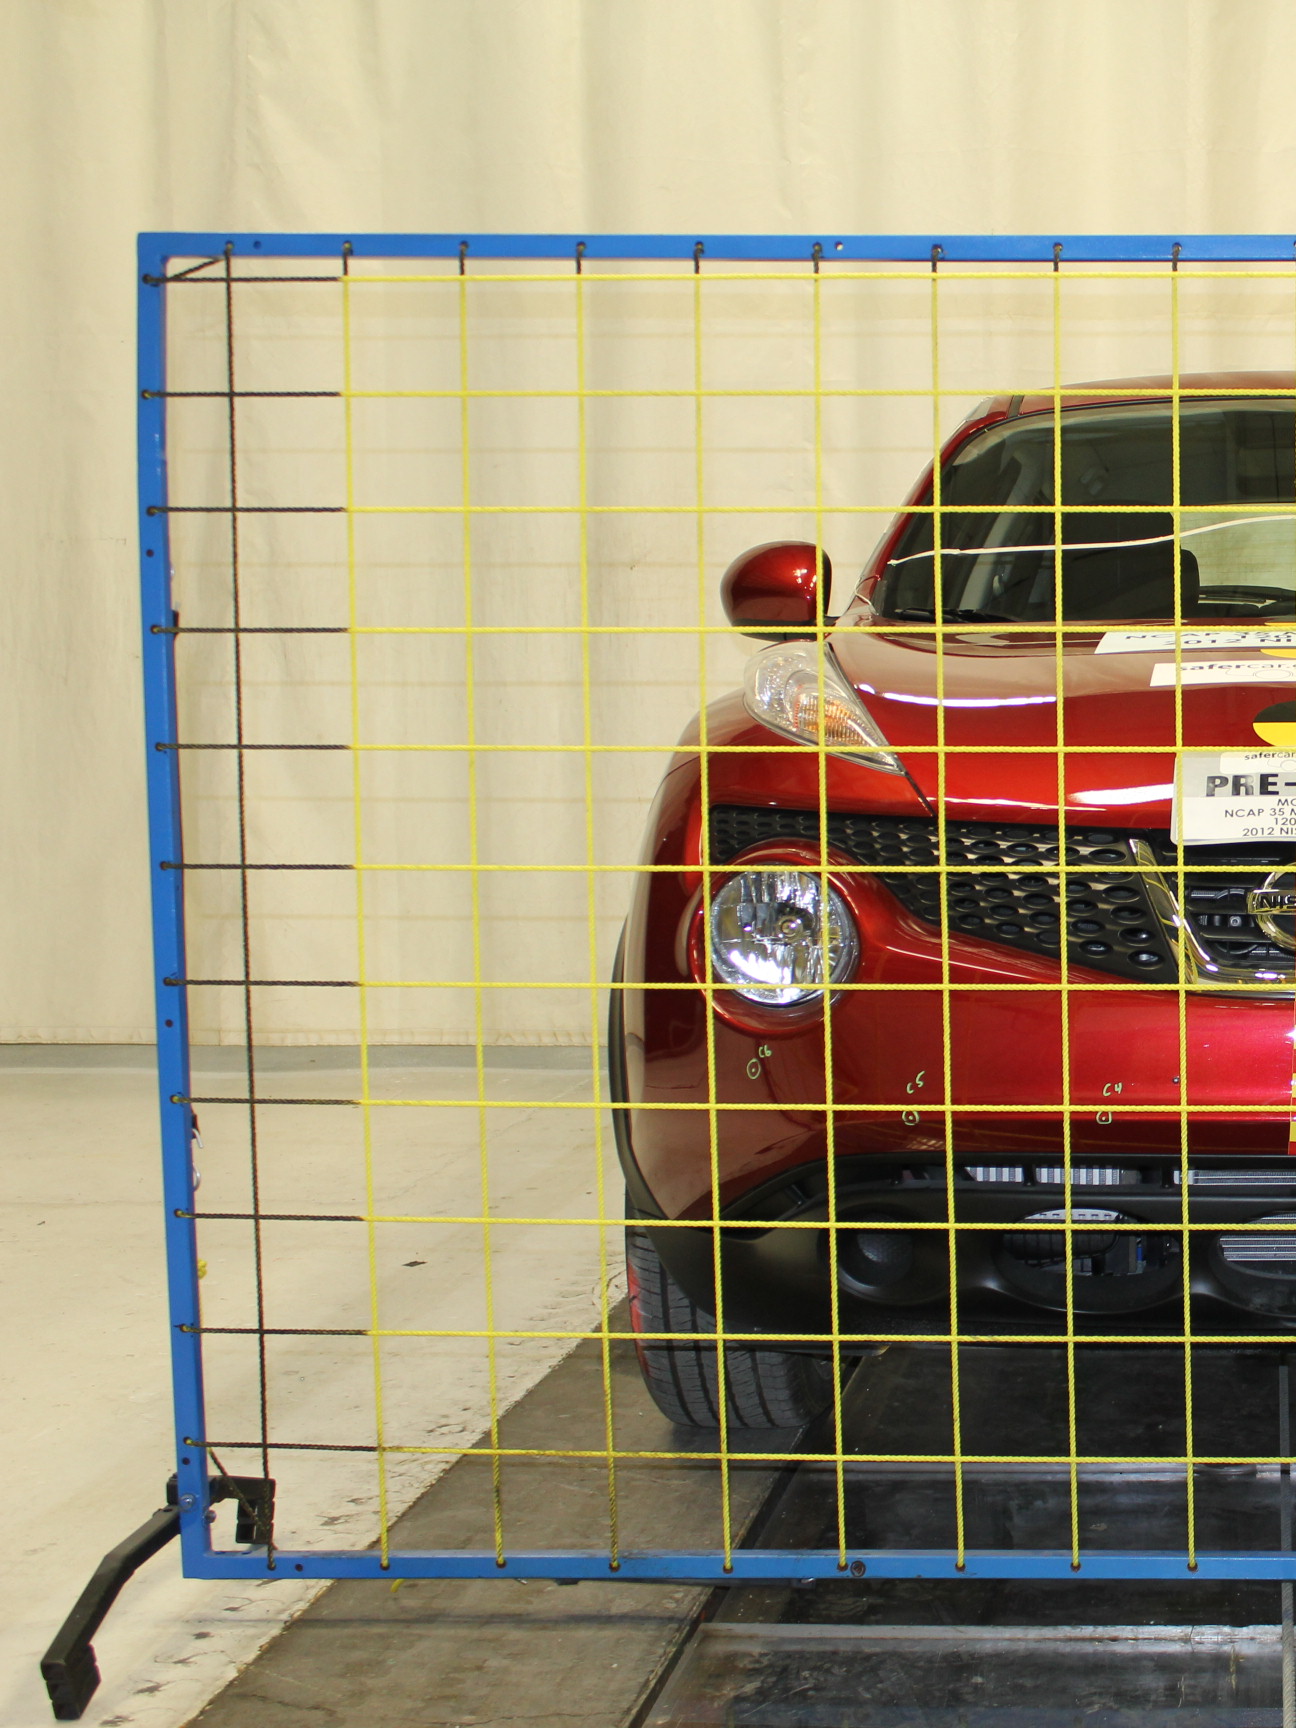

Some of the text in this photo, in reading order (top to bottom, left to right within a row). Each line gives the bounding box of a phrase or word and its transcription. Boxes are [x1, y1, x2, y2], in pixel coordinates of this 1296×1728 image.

[1125, 632, 1220, 640] NCAP
[1164, 638, 1242, 646] 2012
[1224, 808, 1265, 818] NCAP
[1269, 807, 1285, 817] 35
[1242, 827, 1275, 837] 2012
[906, 1070, 926, 1094] C5
[1102, 1082, 1123, 1097] C4
